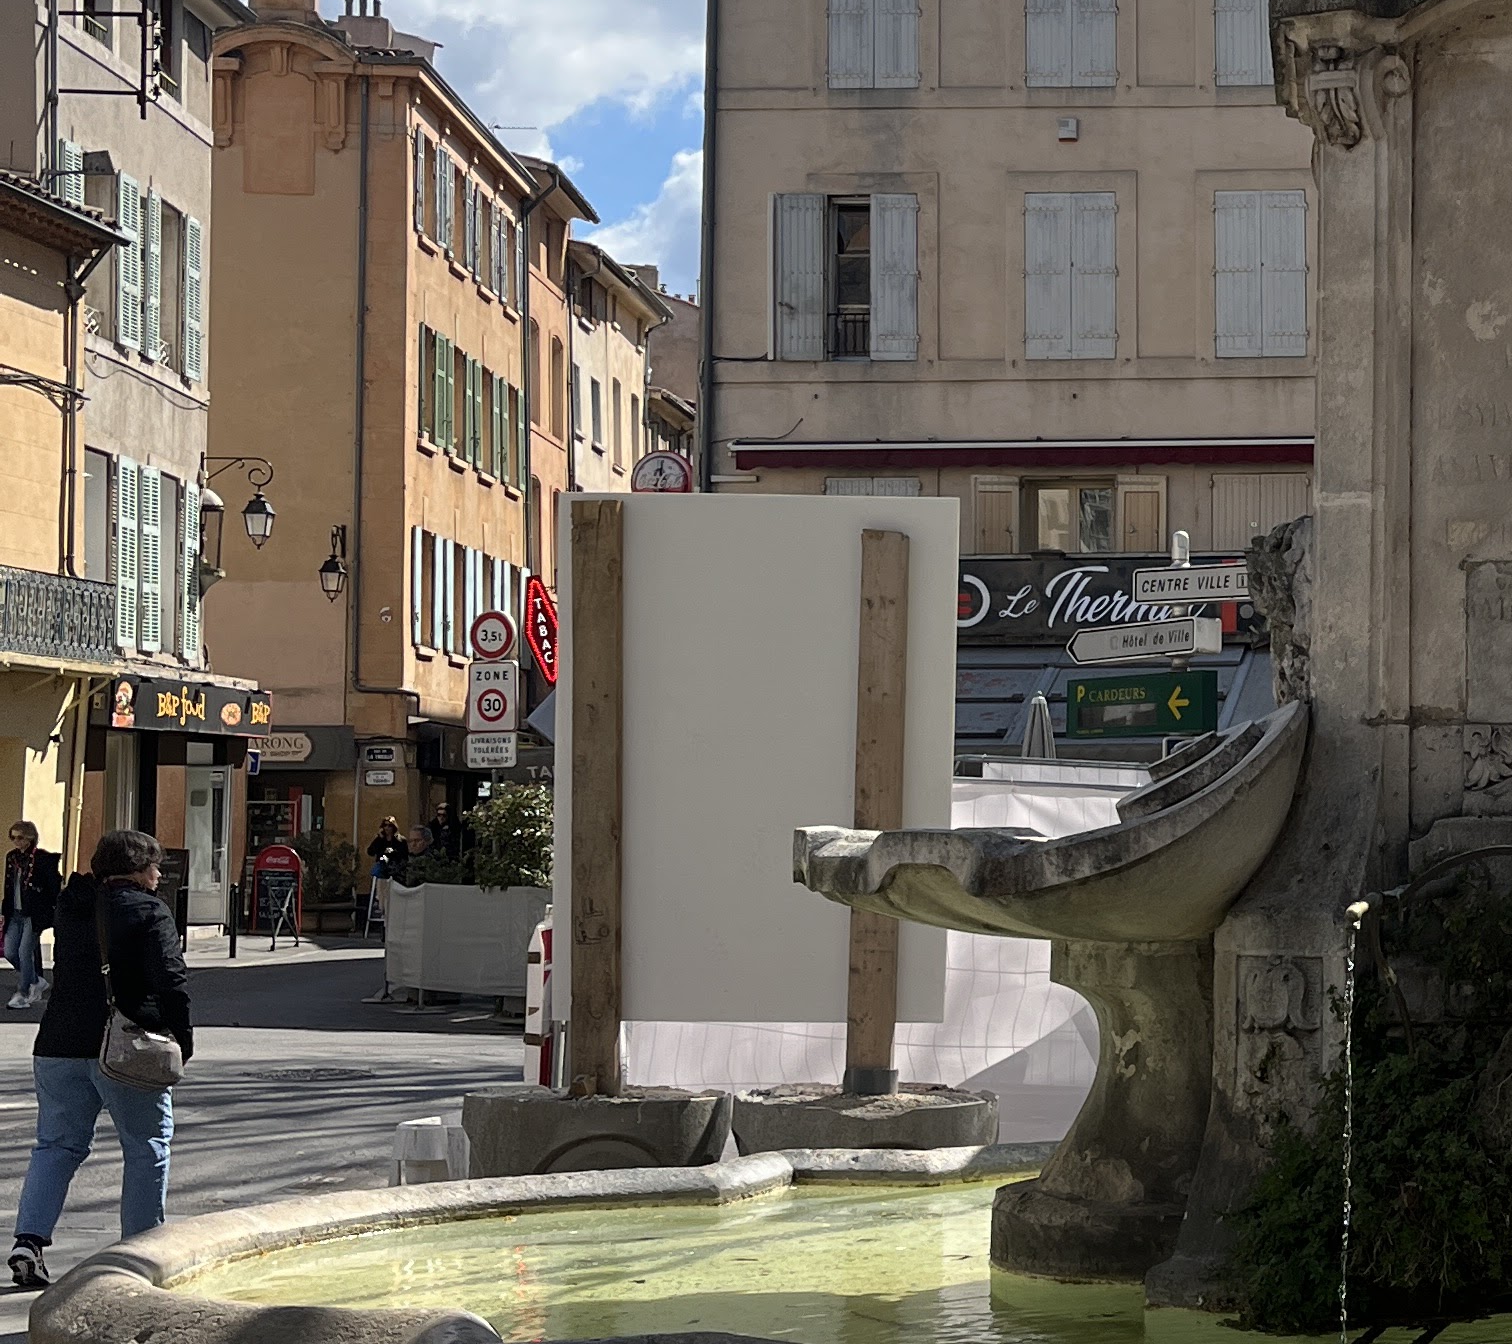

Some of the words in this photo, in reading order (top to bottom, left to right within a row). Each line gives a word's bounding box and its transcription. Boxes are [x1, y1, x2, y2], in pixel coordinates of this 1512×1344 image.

[1142, 578, 1189, 593] CENTRE
[1198, 575, 1230, 590] VILLE
[1000, 584, 1040, 618] Le
[534, 598, 554, 663] TABAC
[1122, 632, 1147, 648] Hôtel
[1153, 631, 1163, 644] de
[1168, 629, 1190, 643] Ville
[476, 671, 509, 681] ZONE
[1089, 687, 1146, 702] CARDEURS
[157, 692, 179, 717] B&P
[484, 699, 501, 711] 30
[471, 737, 512, 745] LIVRAISONS
[526, 766, 555, 778] TA
